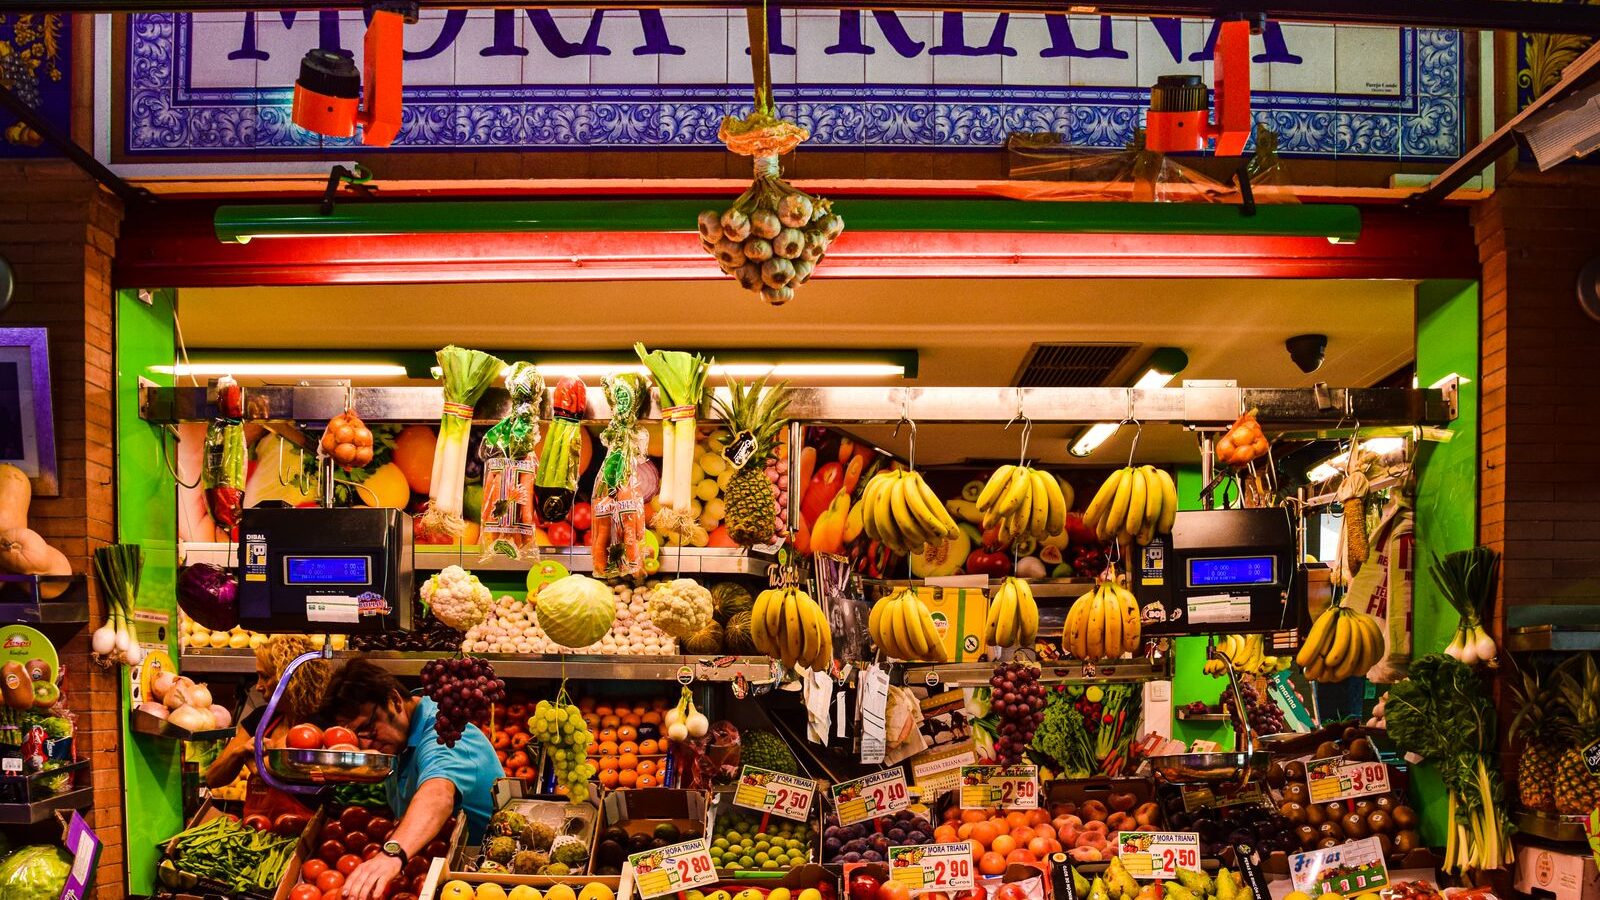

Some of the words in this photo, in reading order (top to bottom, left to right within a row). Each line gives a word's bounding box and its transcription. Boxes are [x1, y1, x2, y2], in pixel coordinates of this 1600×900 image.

[1274, 675, 1281, 686] la
[1279, 684, 1298, 709] marina
[942, 758, 961, 767] TRIANA
[881, 769, 901, 780] TRIANA
[793, 778, 813, 789] TRIANA
[1157, 834, 1174, 842] MORA
[1175, 834, 1195, 842] TRIANA
[664, 847, 682, 855] MORA
[682, 841, 702, 851] TRIANA
[927, 845, 946, 854] MORA
[946, 844, 968, 852] TRIANA
